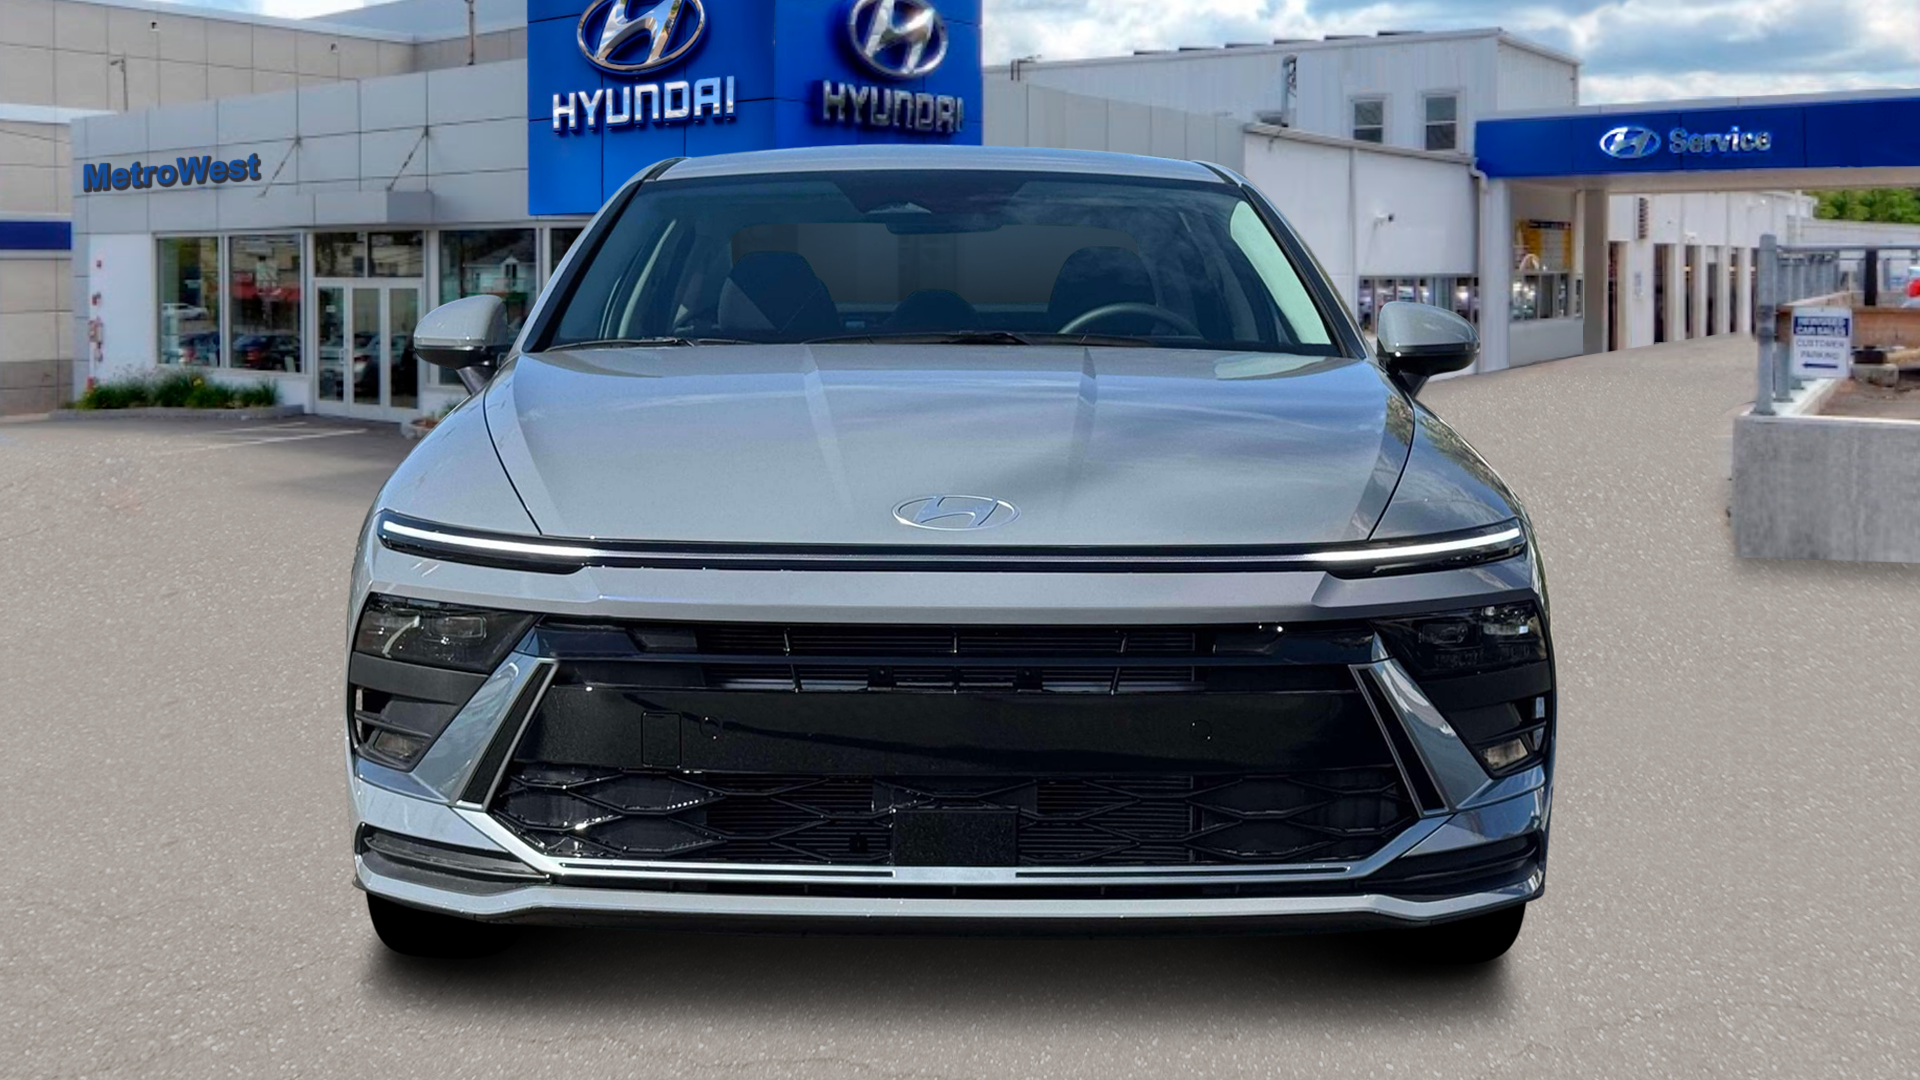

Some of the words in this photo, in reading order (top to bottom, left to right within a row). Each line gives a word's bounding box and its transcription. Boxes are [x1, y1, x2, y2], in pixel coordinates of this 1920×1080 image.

[552, 75, 736, 132] HYUNDAI
[822, 80, 964, 133] HYUNDAI
[1669, 125, 1771, 153] Service
[83, 153, 261, 192] MetroWest
[1796, 339, 1845, 348] CUSTOMER
[1800, 350, 1840, 360] PARKING
